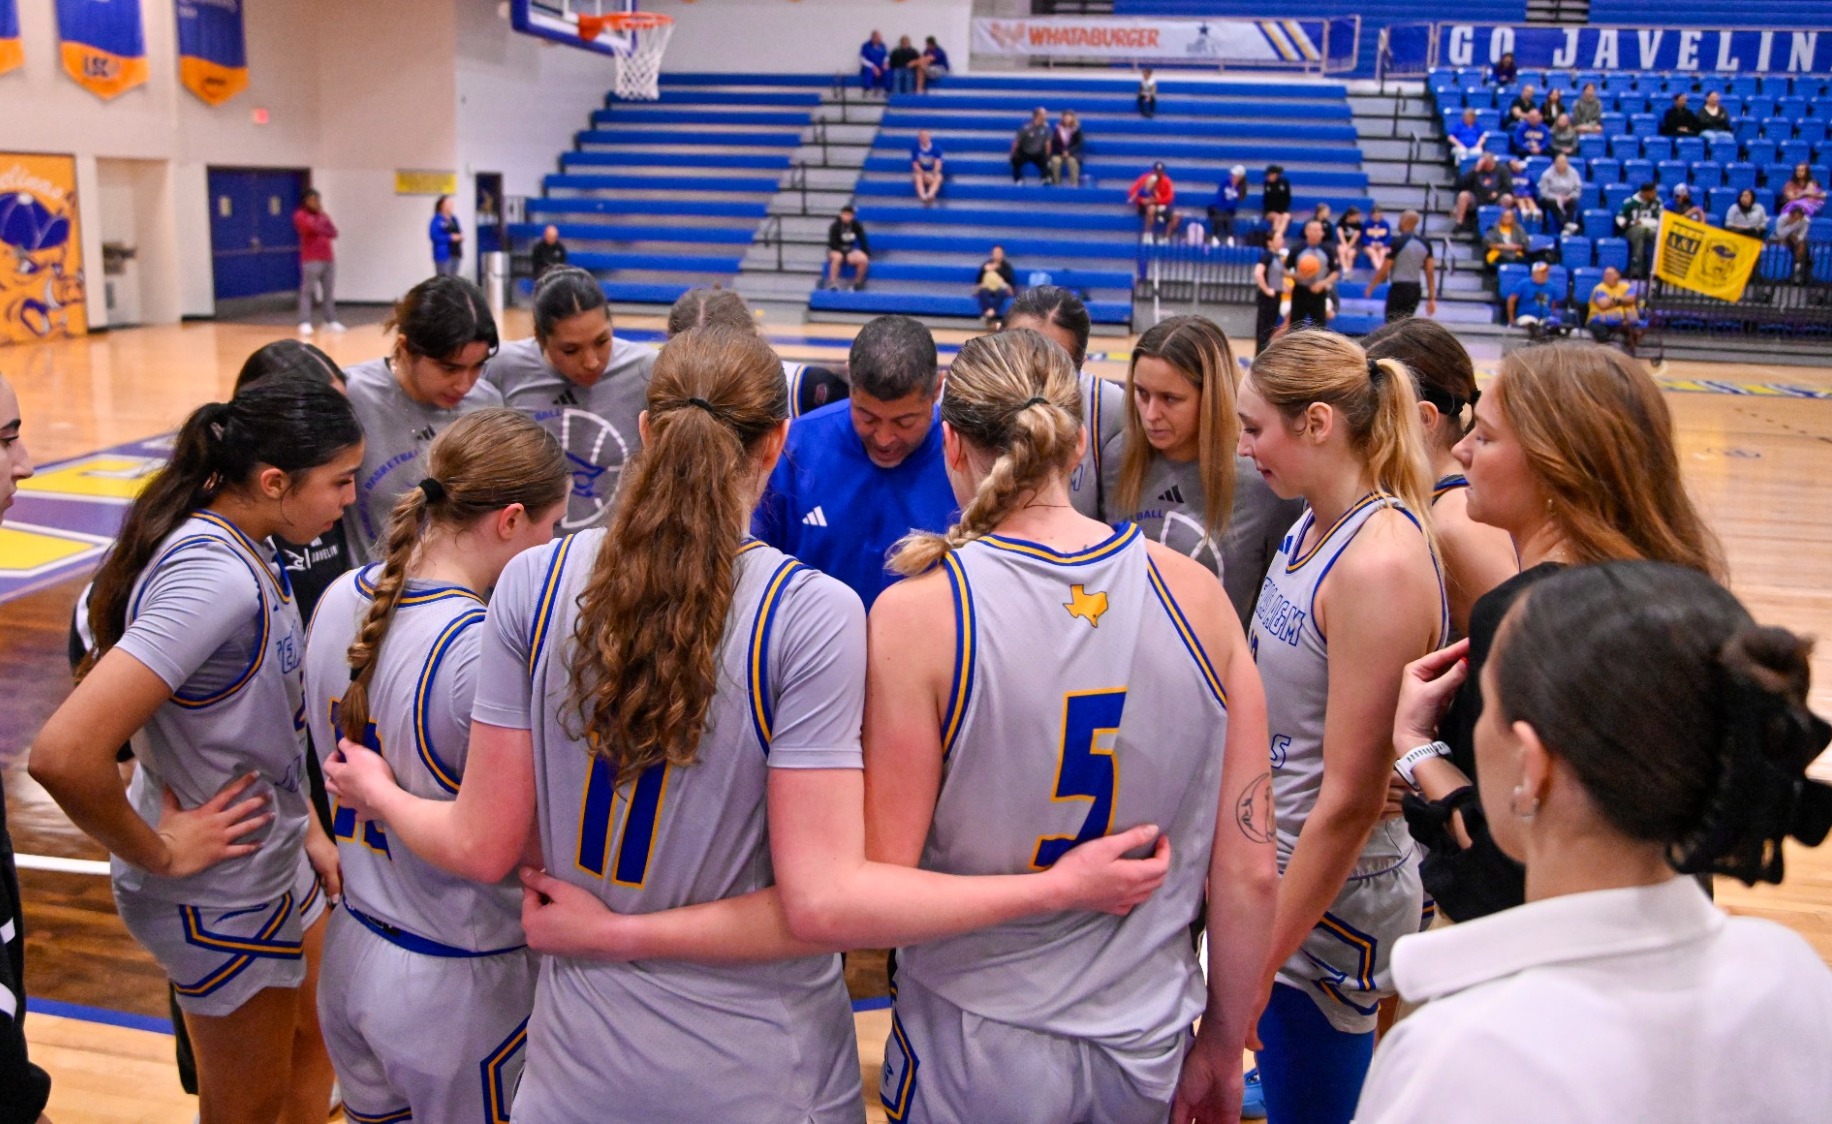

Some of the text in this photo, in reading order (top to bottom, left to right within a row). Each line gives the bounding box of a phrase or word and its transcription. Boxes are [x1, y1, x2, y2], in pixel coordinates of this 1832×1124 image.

[1028, 26, 1160, 48] WHATABURGER
[1449, 26, 1832, 72] GO JAVELIN
[1027, 684, 1128, 872] 5
